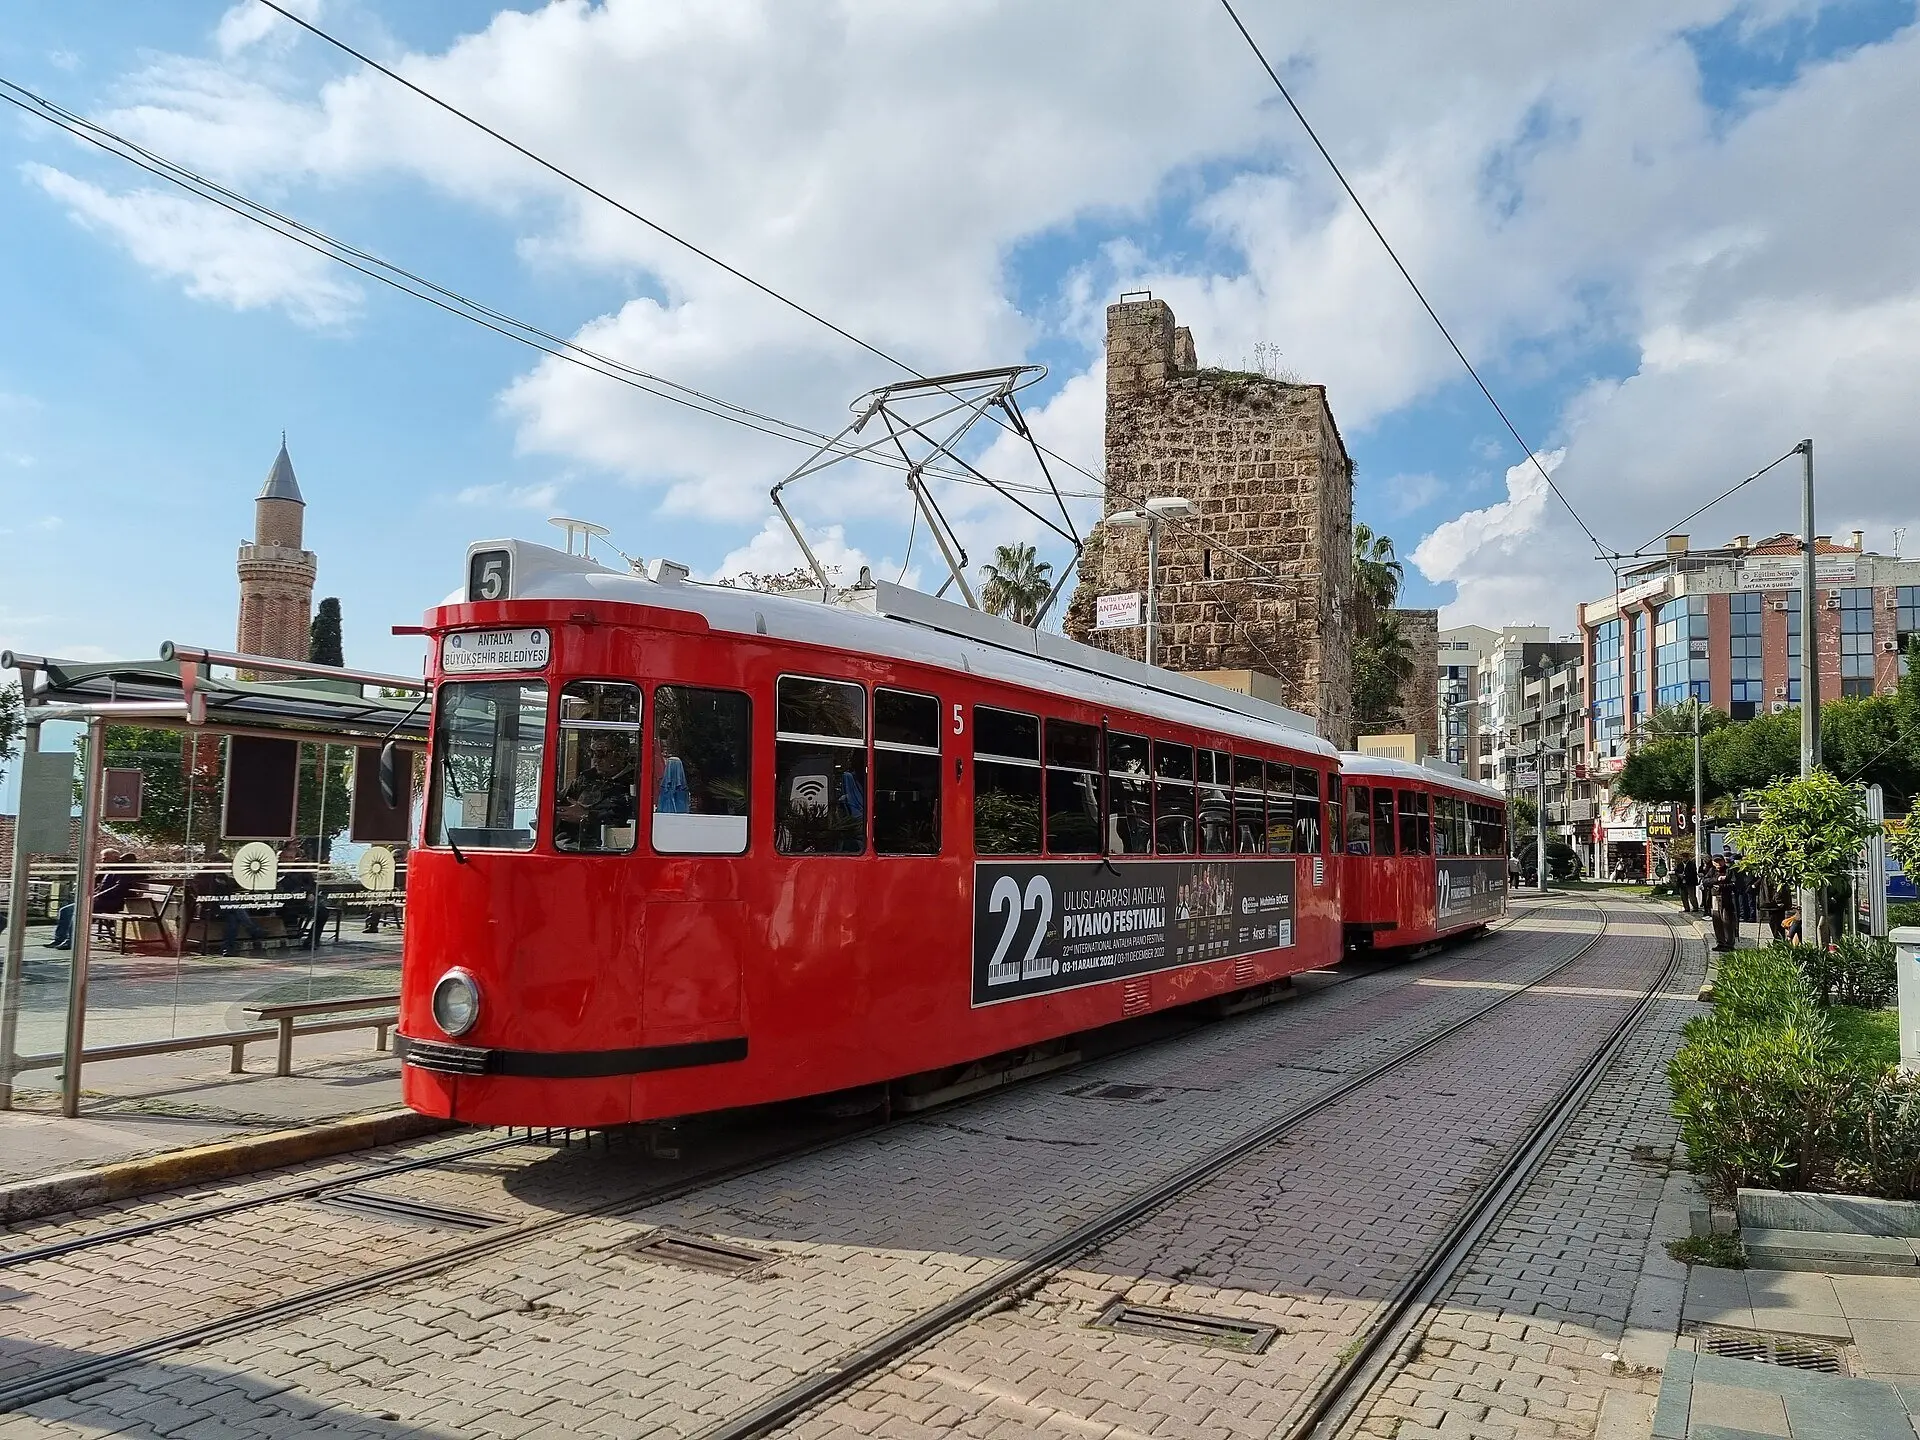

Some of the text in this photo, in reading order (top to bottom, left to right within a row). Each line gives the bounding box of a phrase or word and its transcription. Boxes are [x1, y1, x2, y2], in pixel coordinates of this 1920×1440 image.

[481, 560, 503, 600] 5
[1098, 602, 1137, 612] ANTALYAM
[477, 632, 514, 647] ANTALYA
[445, 646, 547, 668] BÜYÜKŞEHİR BELEDİYESİ
[953, 704, 964, 735] 5
[1649, 824, 1673, 835] OPTİK
[195, 894, 229, 902] ANTALYA
[1063, 886, 1166, 911] ULUSLARARASI ANTALYA
[1073, 940, 1112, 955] INTERNATIONAL
[1112, 937, 1132, 949] ANTALYA
[1132, 935, 1147, 946] PIANO
[1062, 961, 1078, 973] 03-11
[1077, 957, 1100, 971] ARALIK
